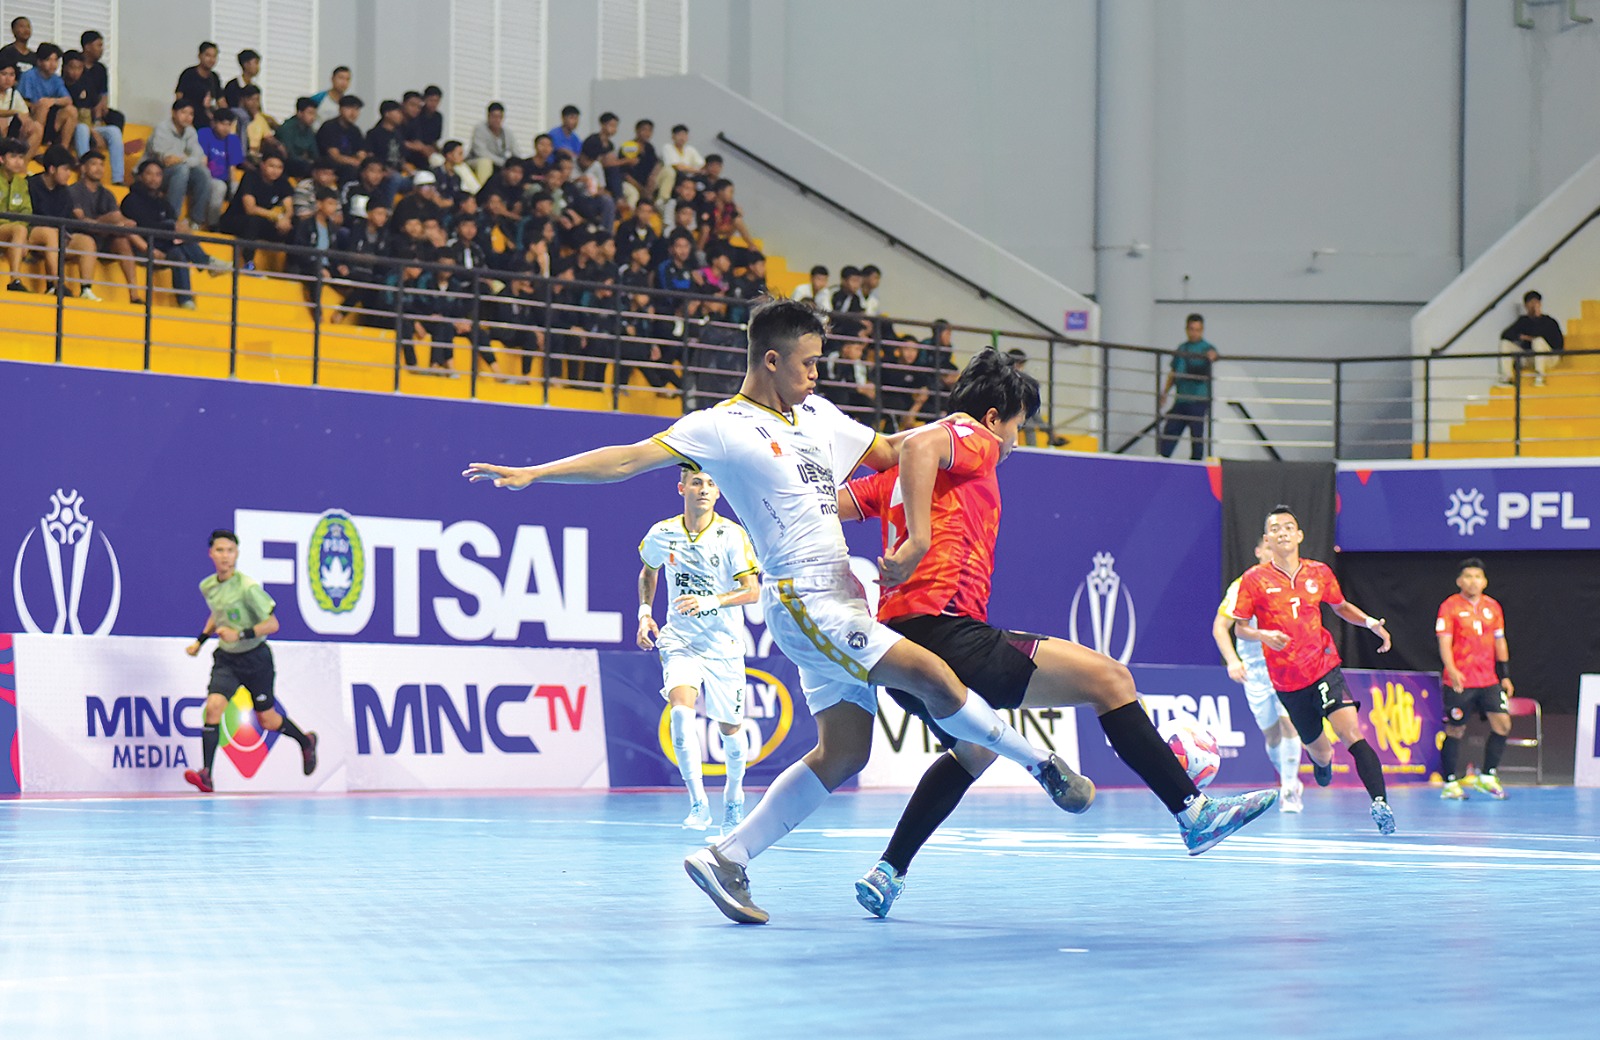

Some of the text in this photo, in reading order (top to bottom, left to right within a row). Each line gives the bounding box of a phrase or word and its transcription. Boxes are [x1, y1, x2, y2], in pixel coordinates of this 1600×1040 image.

[1497, 491, 1591, 530] PFL
[234, 508, 623, 643] FUTSAL
[1289, 596, 1301, 619] 7
[86, 695, 207, 738] MNC
[351, 683, 588, 755] MNC TV
[1137, 692, 1246, 748] TSAL
[112, 744, 189, 769] MEDIA
